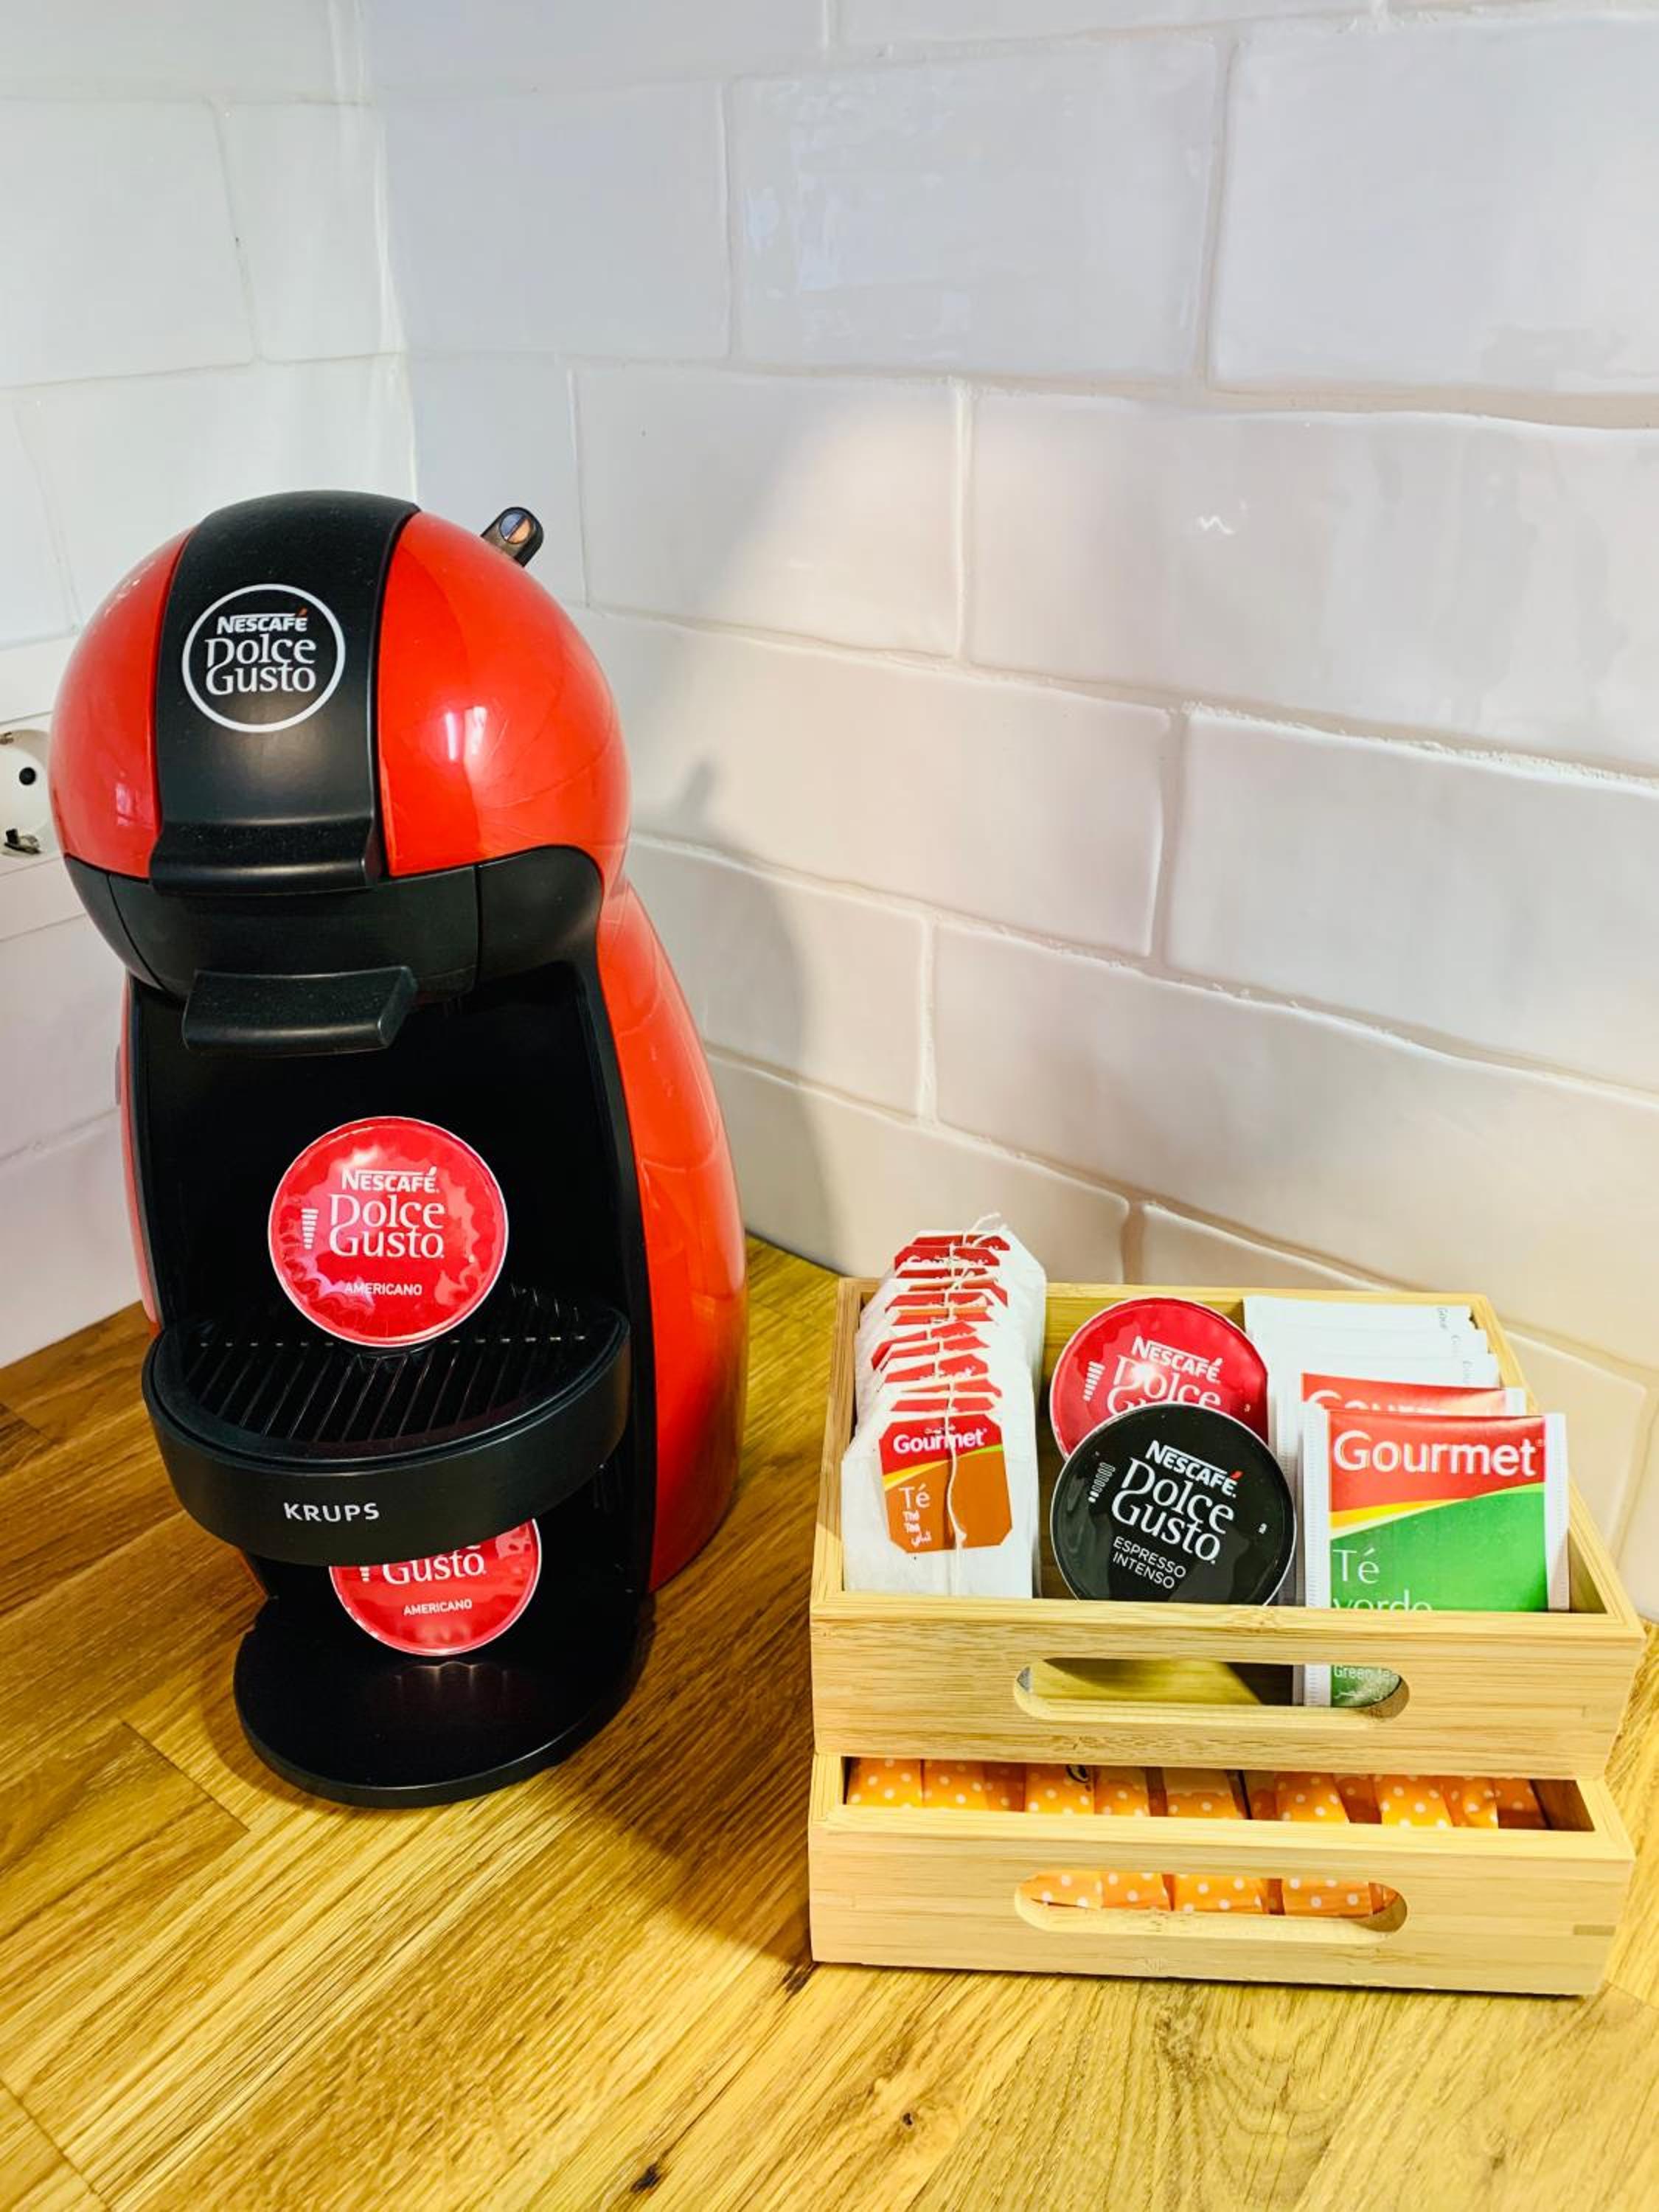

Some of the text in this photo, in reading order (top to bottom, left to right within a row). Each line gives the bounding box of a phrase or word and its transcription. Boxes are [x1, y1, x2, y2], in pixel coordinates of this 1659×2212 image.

[217, 606, 308, 634] NESCAFÉ
[204, 633, 316, 667] Dolce
[206, 662, 316, 695] Gusto
[341, 1166, 439, 1193] NESCAFÉ
[330, 1193, 445, 1229] Dolce
[329, 1224, 445, 1258] Gusto
[344, 1282, 422, 1296] AMERICANO
[1131, 1335, 1224, 1384] NESCAFÉ
[1145, 1440, 1244, 1498] NESCAFÉ
[1333, 1429, 1536, 1477] Gourmet
[283, 1502, 380, 1522] KRUPS
[898, 1483, 931, 1509] Té
[1121, 1457, 1235, 1534] Dolce
[1111, 1489, 1221, 1563] Gusto
[1113, 1536, 1186, 1578] ESPRESSO
[1113, 1551, 1175, 1589] INTENSO
[1332, 1548, 1380, 1585] Té
[403, 1599, 472, 1616] AMERICANO
